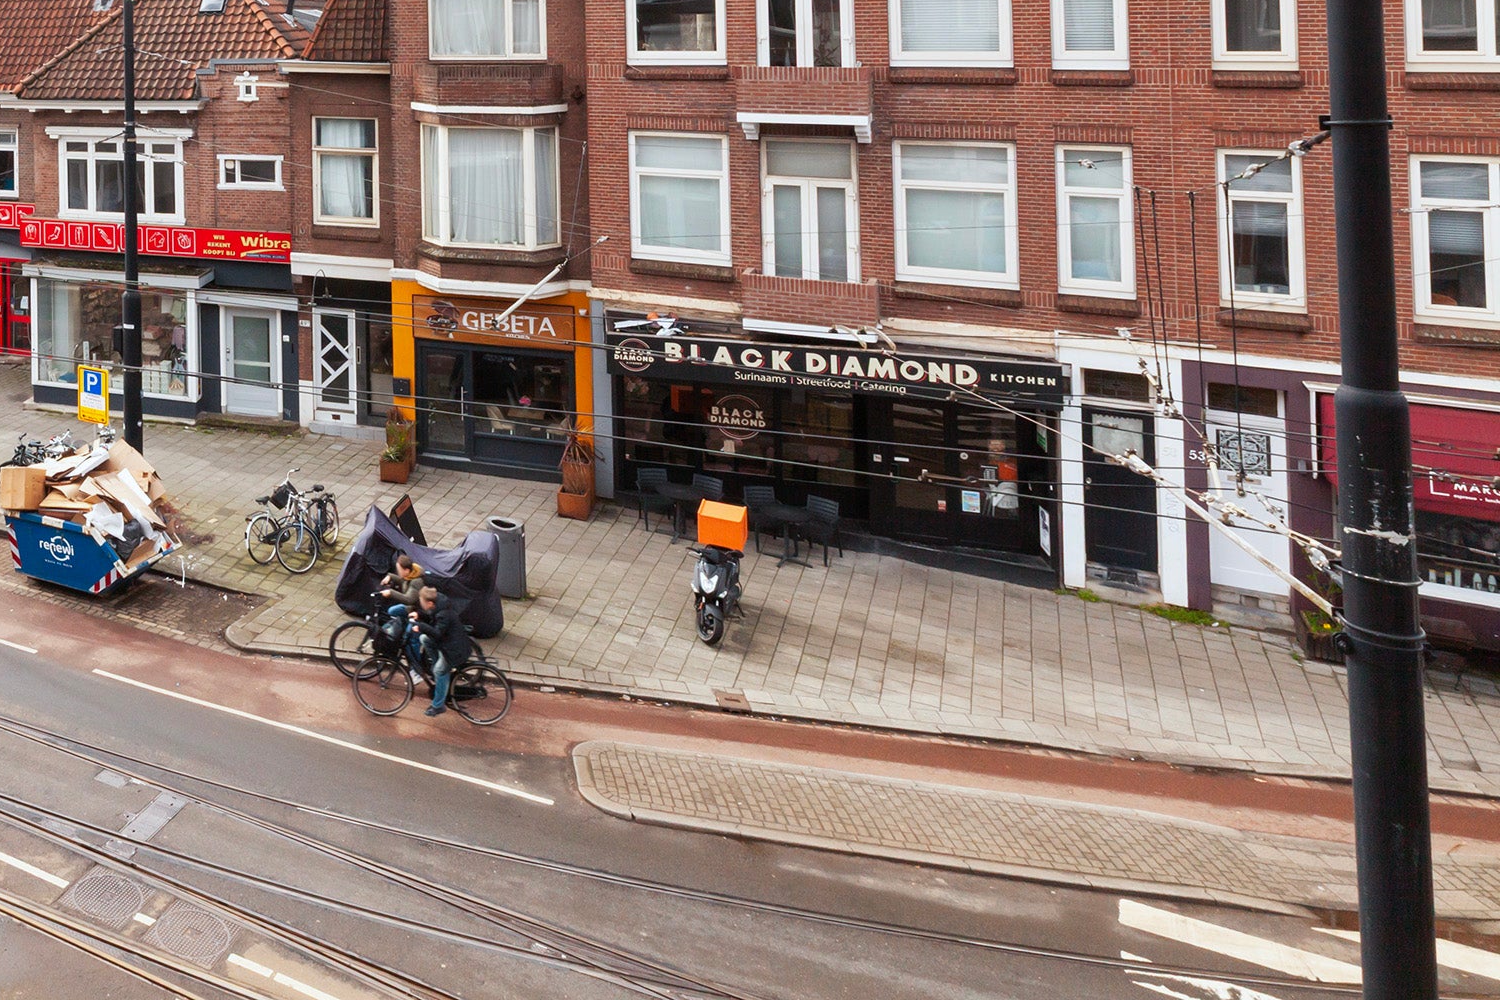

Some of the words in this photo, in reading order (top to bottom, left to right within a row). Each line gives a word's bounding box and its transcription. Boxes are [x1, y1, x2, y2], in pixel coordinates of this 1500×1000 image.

[240, 233, 291, 249] Wibra
[203, 248, 225, 256] KOOPT
[462, 310, 557, 337] GEBETA
[613, 353, 655, 363] DIAMOND
[664, 341, 793, 372] BLACK
[805, 351, 981, 386] DIAMOND
[990, 372, 1057, 387] KITCHEN
[86, 372, 98, 392] P
[734, 370, 787, 384] Surinaams
[796, 376, 851, 389] Streetfood
[861, 380, 907, 395] Catering
[711, 405, 765, 420] BLACK
[710, 415, 766, 428] DIAMOND
[1453, 480, 1500, 497] MAR
[39, 540, 75, 556] renewi
